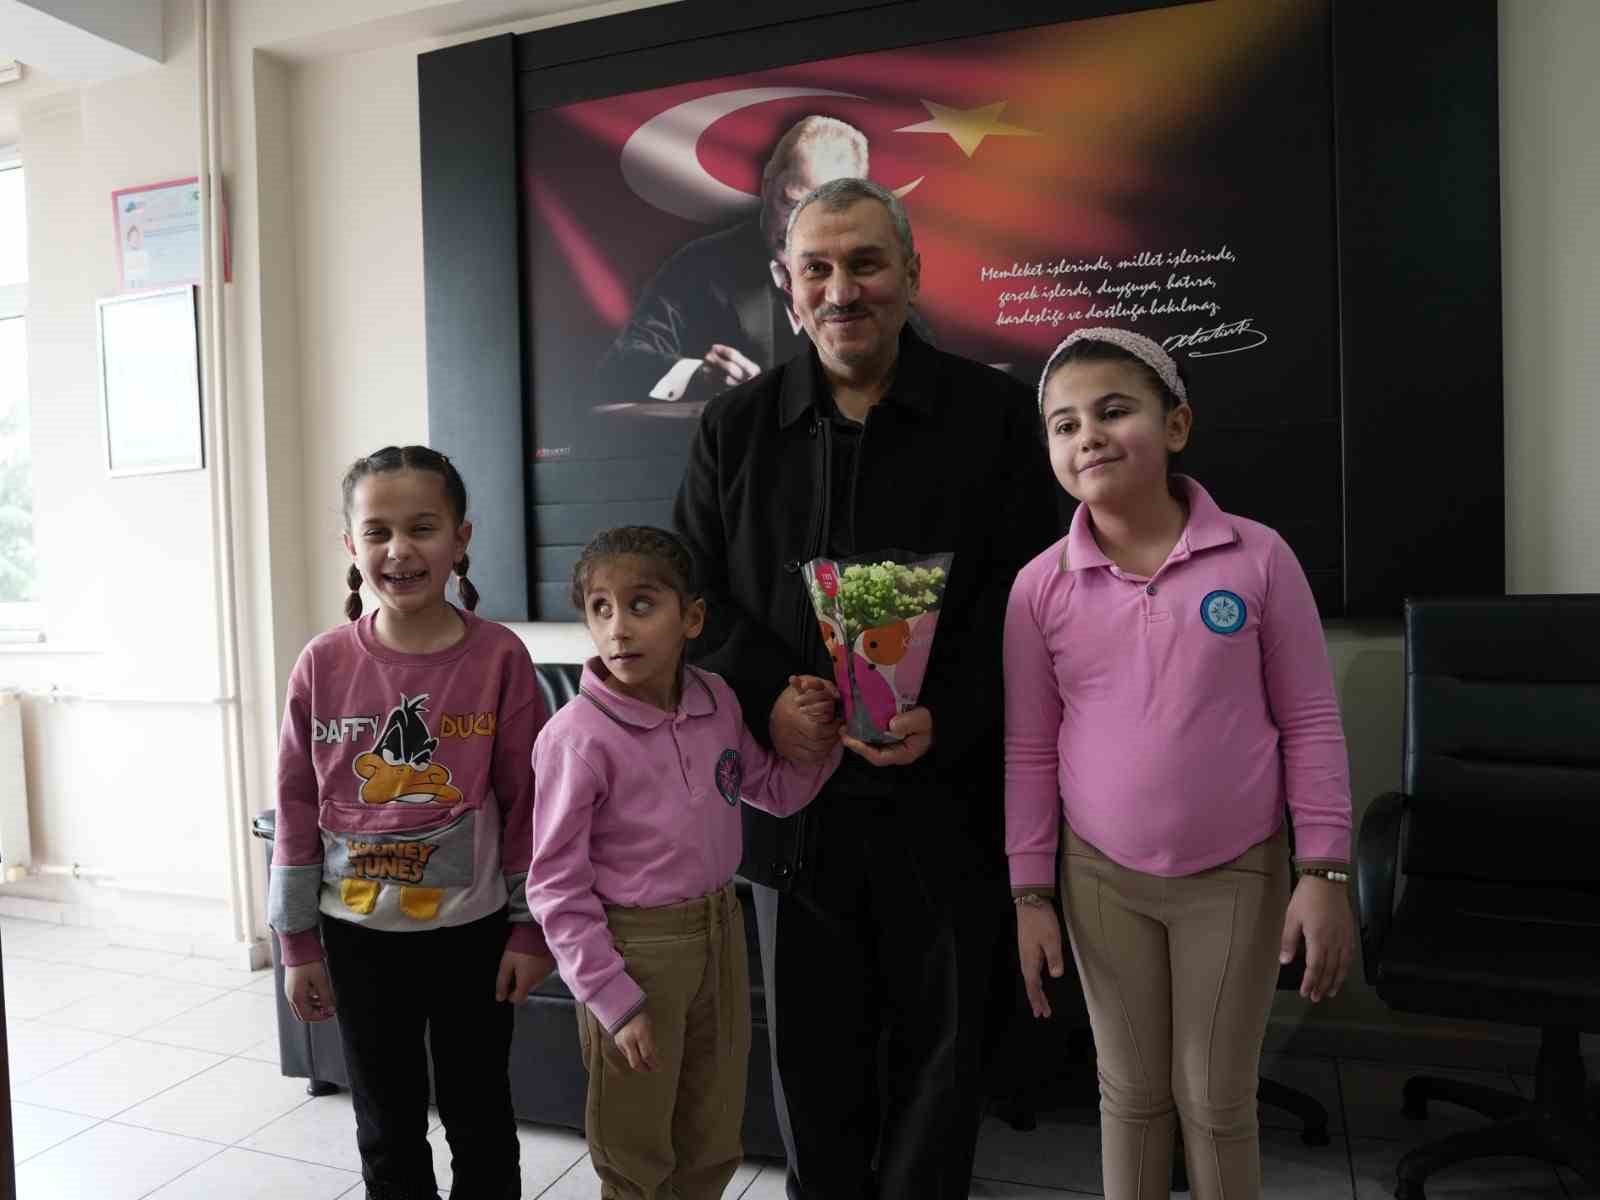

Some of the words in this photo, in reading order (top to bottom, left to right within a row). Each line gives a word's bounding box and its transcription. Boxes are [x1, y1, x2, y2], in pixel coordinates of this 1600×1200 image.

[980, 262, 1044, 281] Memleket
[1046, 255, 1113, 278] işlerinde,
[1116, 251, 1165, 271] millet
[1166, 244, 1236, 269] işlerinde,
[998, 285, 1040, 308] gerçek
[1041, 281, 1092, 302] işlerde,
[1097, 278, 1161, 299] duyguya,
[1166, 272, 1217, 290] hatıra,
[995, 307, 1066, 328] kardeşliğe
[1066, 310, 1083, 321] ve
[1084, 302, 1147, 322] dostluğa
[1149, 296, 1221, 317] bakılmaz.
[311, 714, 380, 744] DAFFY
[350, 857, 424, 883] TUNES
